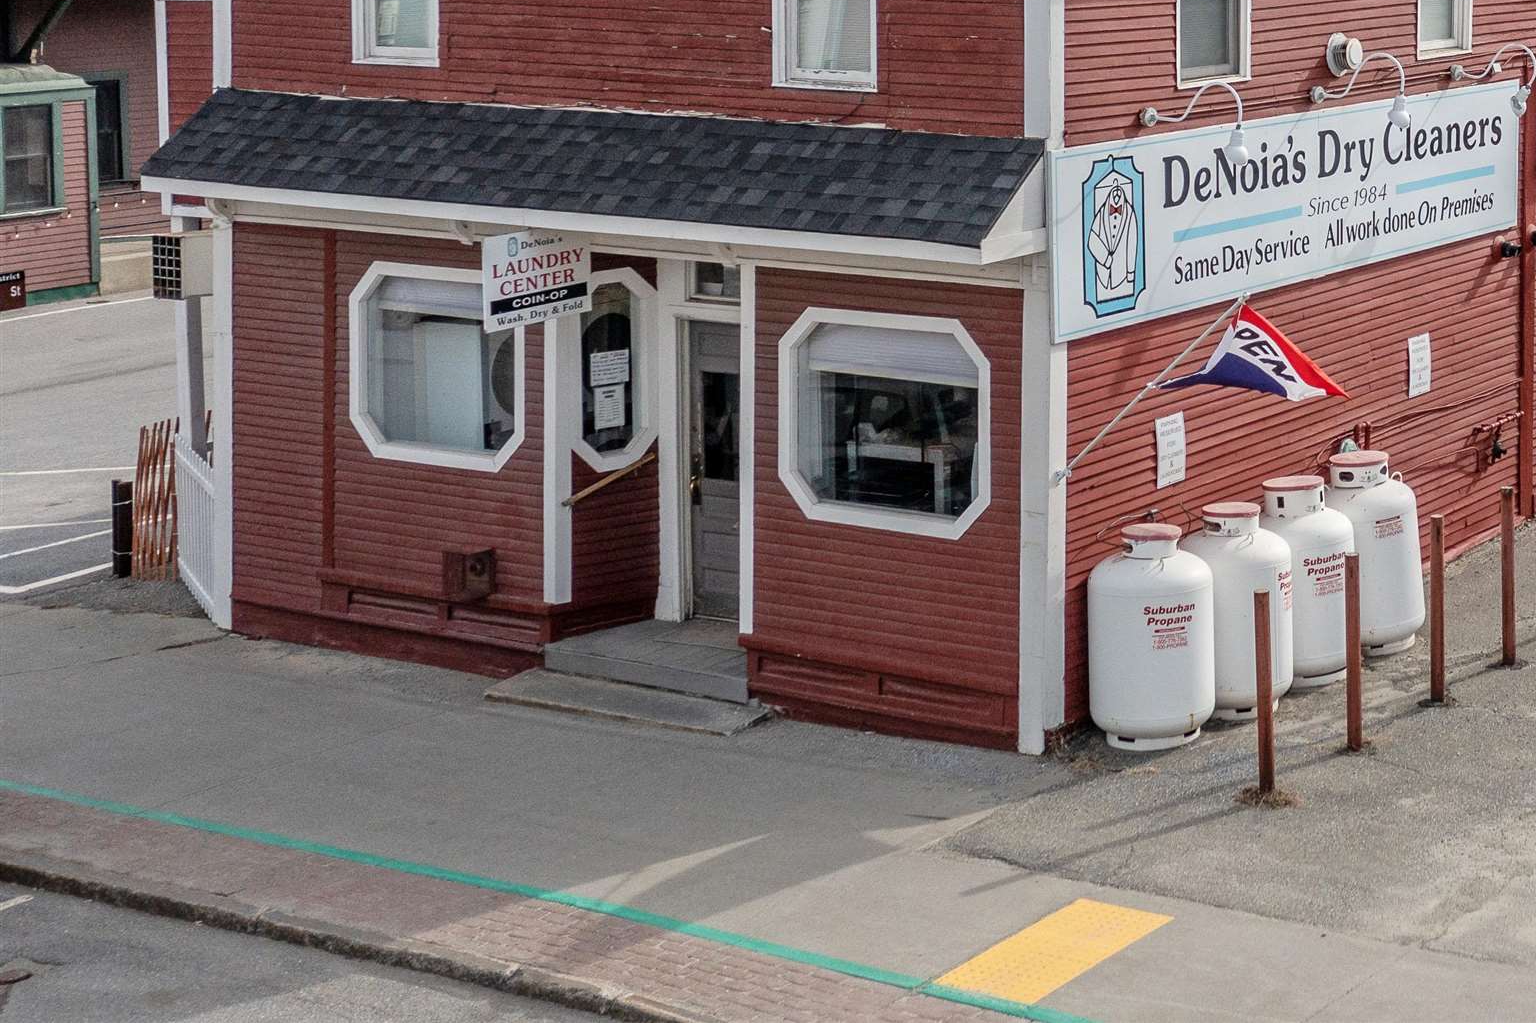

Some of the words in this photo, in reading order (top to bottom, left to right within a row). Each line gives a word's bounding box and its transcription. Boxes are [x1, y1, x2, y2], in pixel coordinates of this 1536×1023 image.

[1162, 135, 1306, 208] DeNoia's
[1317, 129, 1375, 182] Dry
[1383, 114, 1502, 165] Cleaners
[1307, 195, 1349, 217] Since
[1354, 183, 1388, 207] 1984
[1324, 218, 1344, 249] All
[1346, 210, 1380, 243] work
[1383, 207, 1416, 234] done
[1418, 200, 1437, 226] On
[1440, 188, 1495, 221] Premises
[521, 237, 562, 250] DeNoia's
[492, 248, 584, 279] LAUNDRY
[1174, 256, 1219, 285] Same
[1222, 244, 1253, 275] Day
[1255, 229, 1310, 266] Service
[10, 285, 21, 297] St
[500, 268, 575, 296] CENTER
[512, 289, 568, 308] COIN-OP
[530, 310, 548, 320] Dry
[552, 306, 560, 314] &
[563, 300, 583, 312] Fold
[1303, 551, 1346, 567] Suburban
[1307, 562, 1345, 576] Propane
[1143, 603, 1196, 616] Suburban
[1146, 615, 1193, 627] Propane
